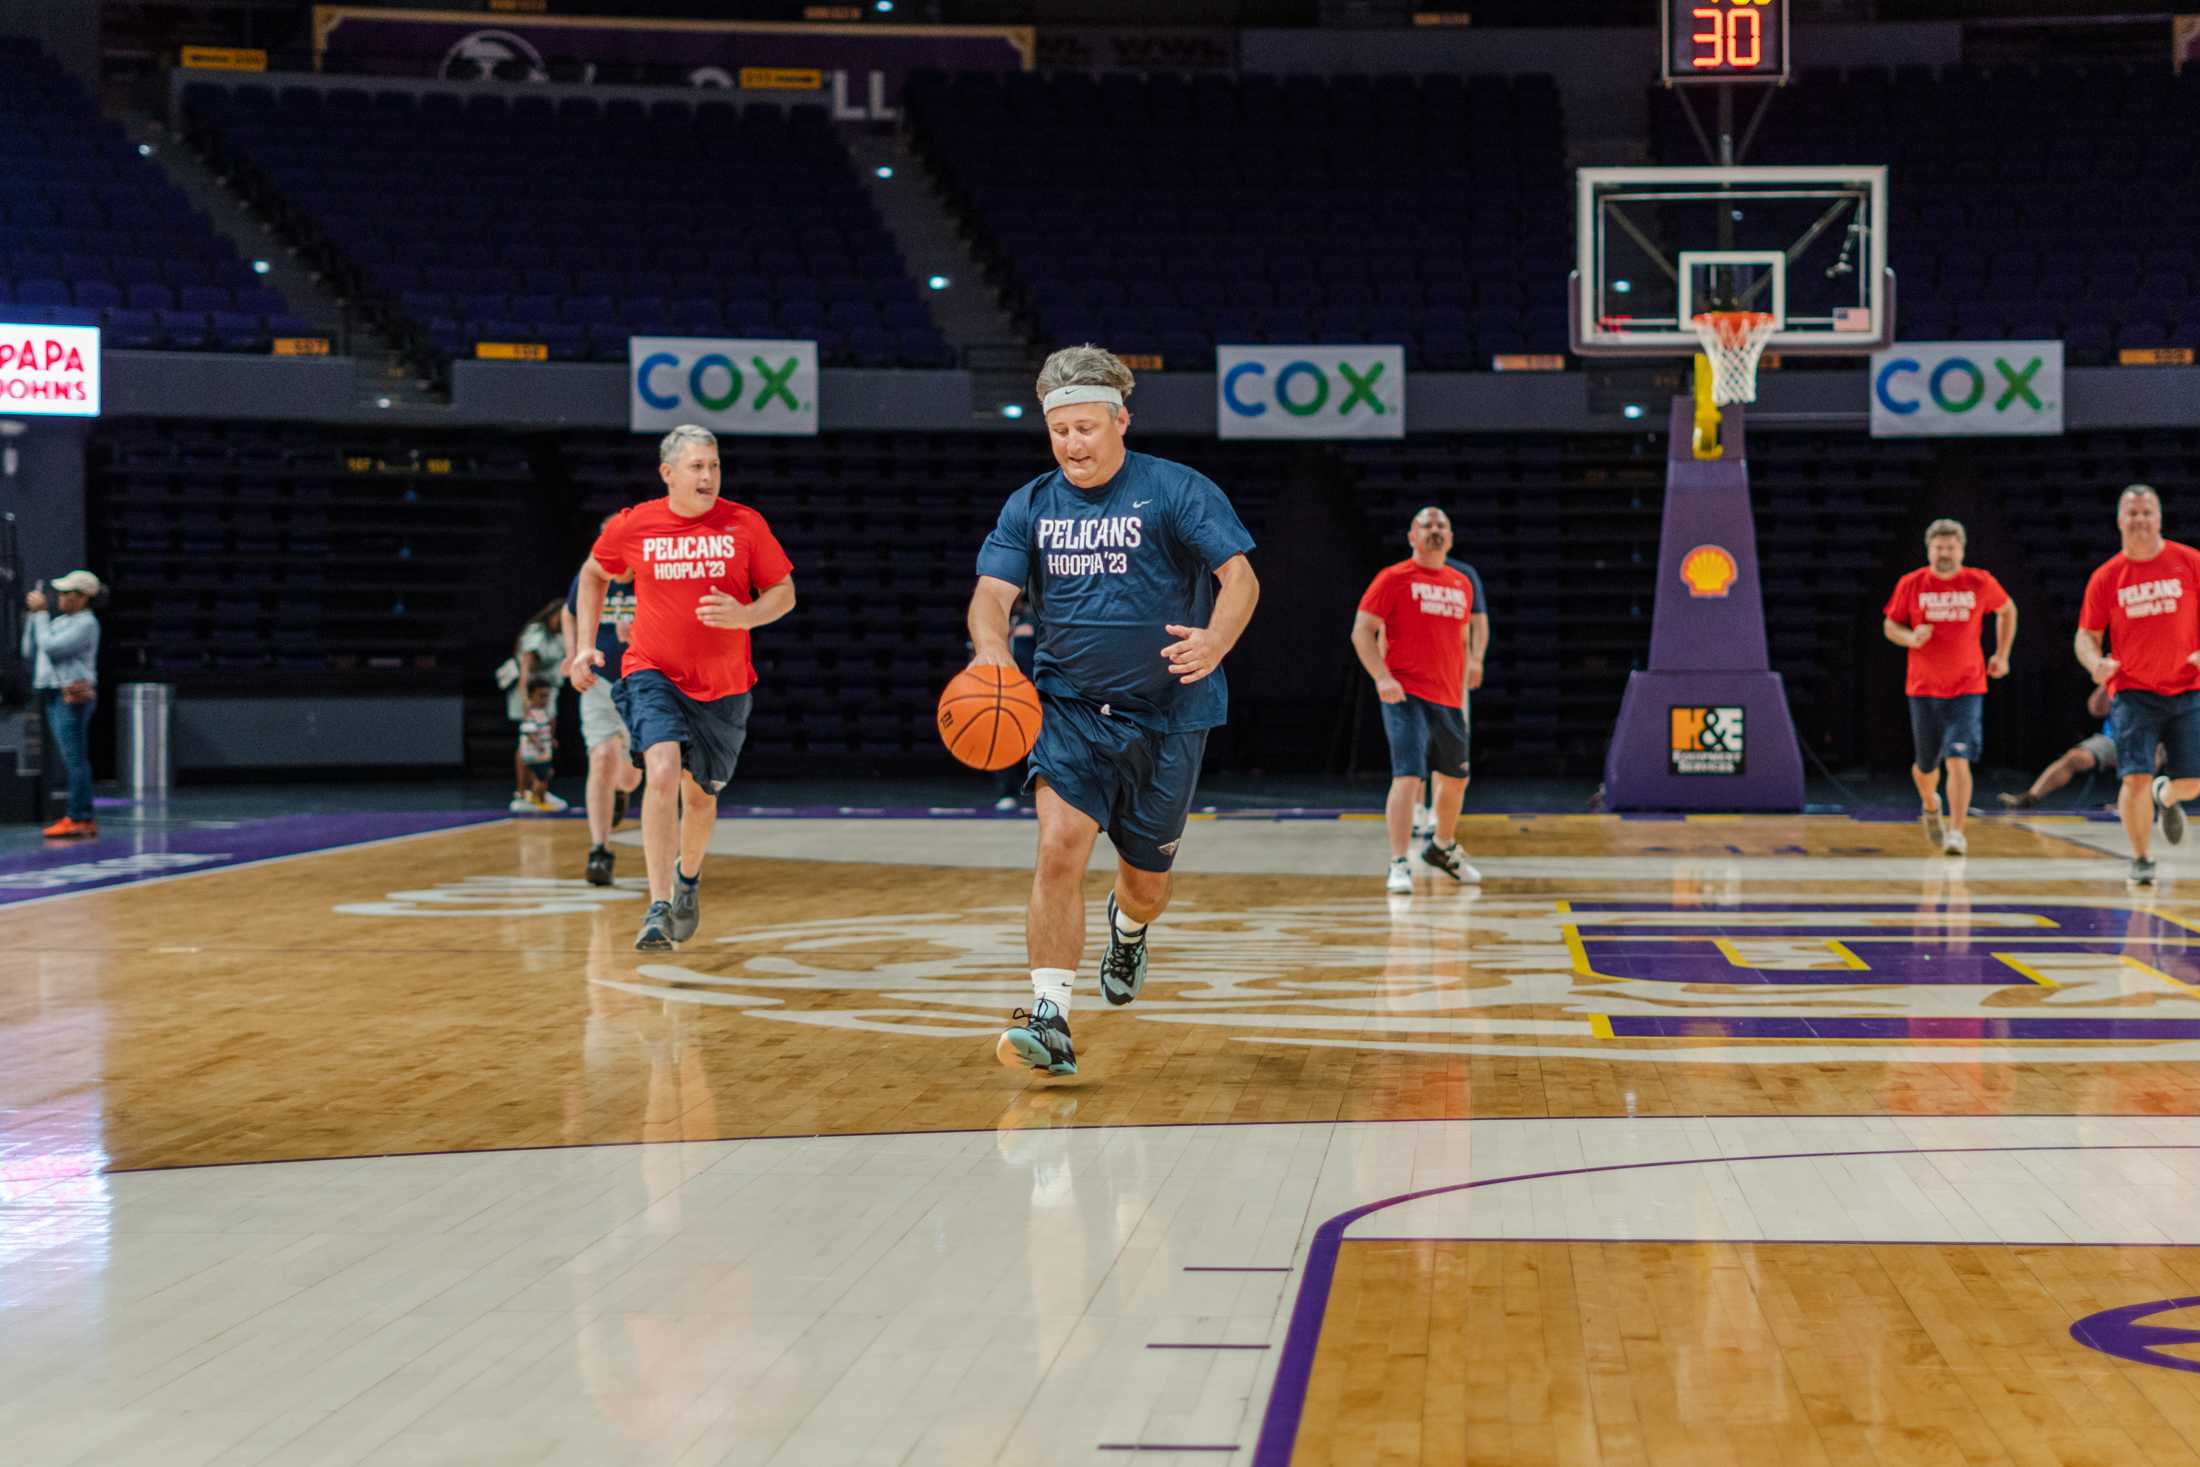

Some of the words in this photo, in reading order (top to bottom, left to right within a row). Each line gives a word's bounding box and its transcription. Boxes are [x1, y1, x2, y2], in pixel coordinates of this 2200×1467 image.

[1692, 7, 1761, 68] 30
[0, 340, 84, 372] PAPA
[637, 352, 799, 411] COX
[1223, 360, 1385, 417] COX
[1876, 356, 2042, 415] COX
[642, 535, 736, 561] PELICANS
[1038, 516, 1142, 550] PELICANS
[1672, 708, 1744, 751] H&E
